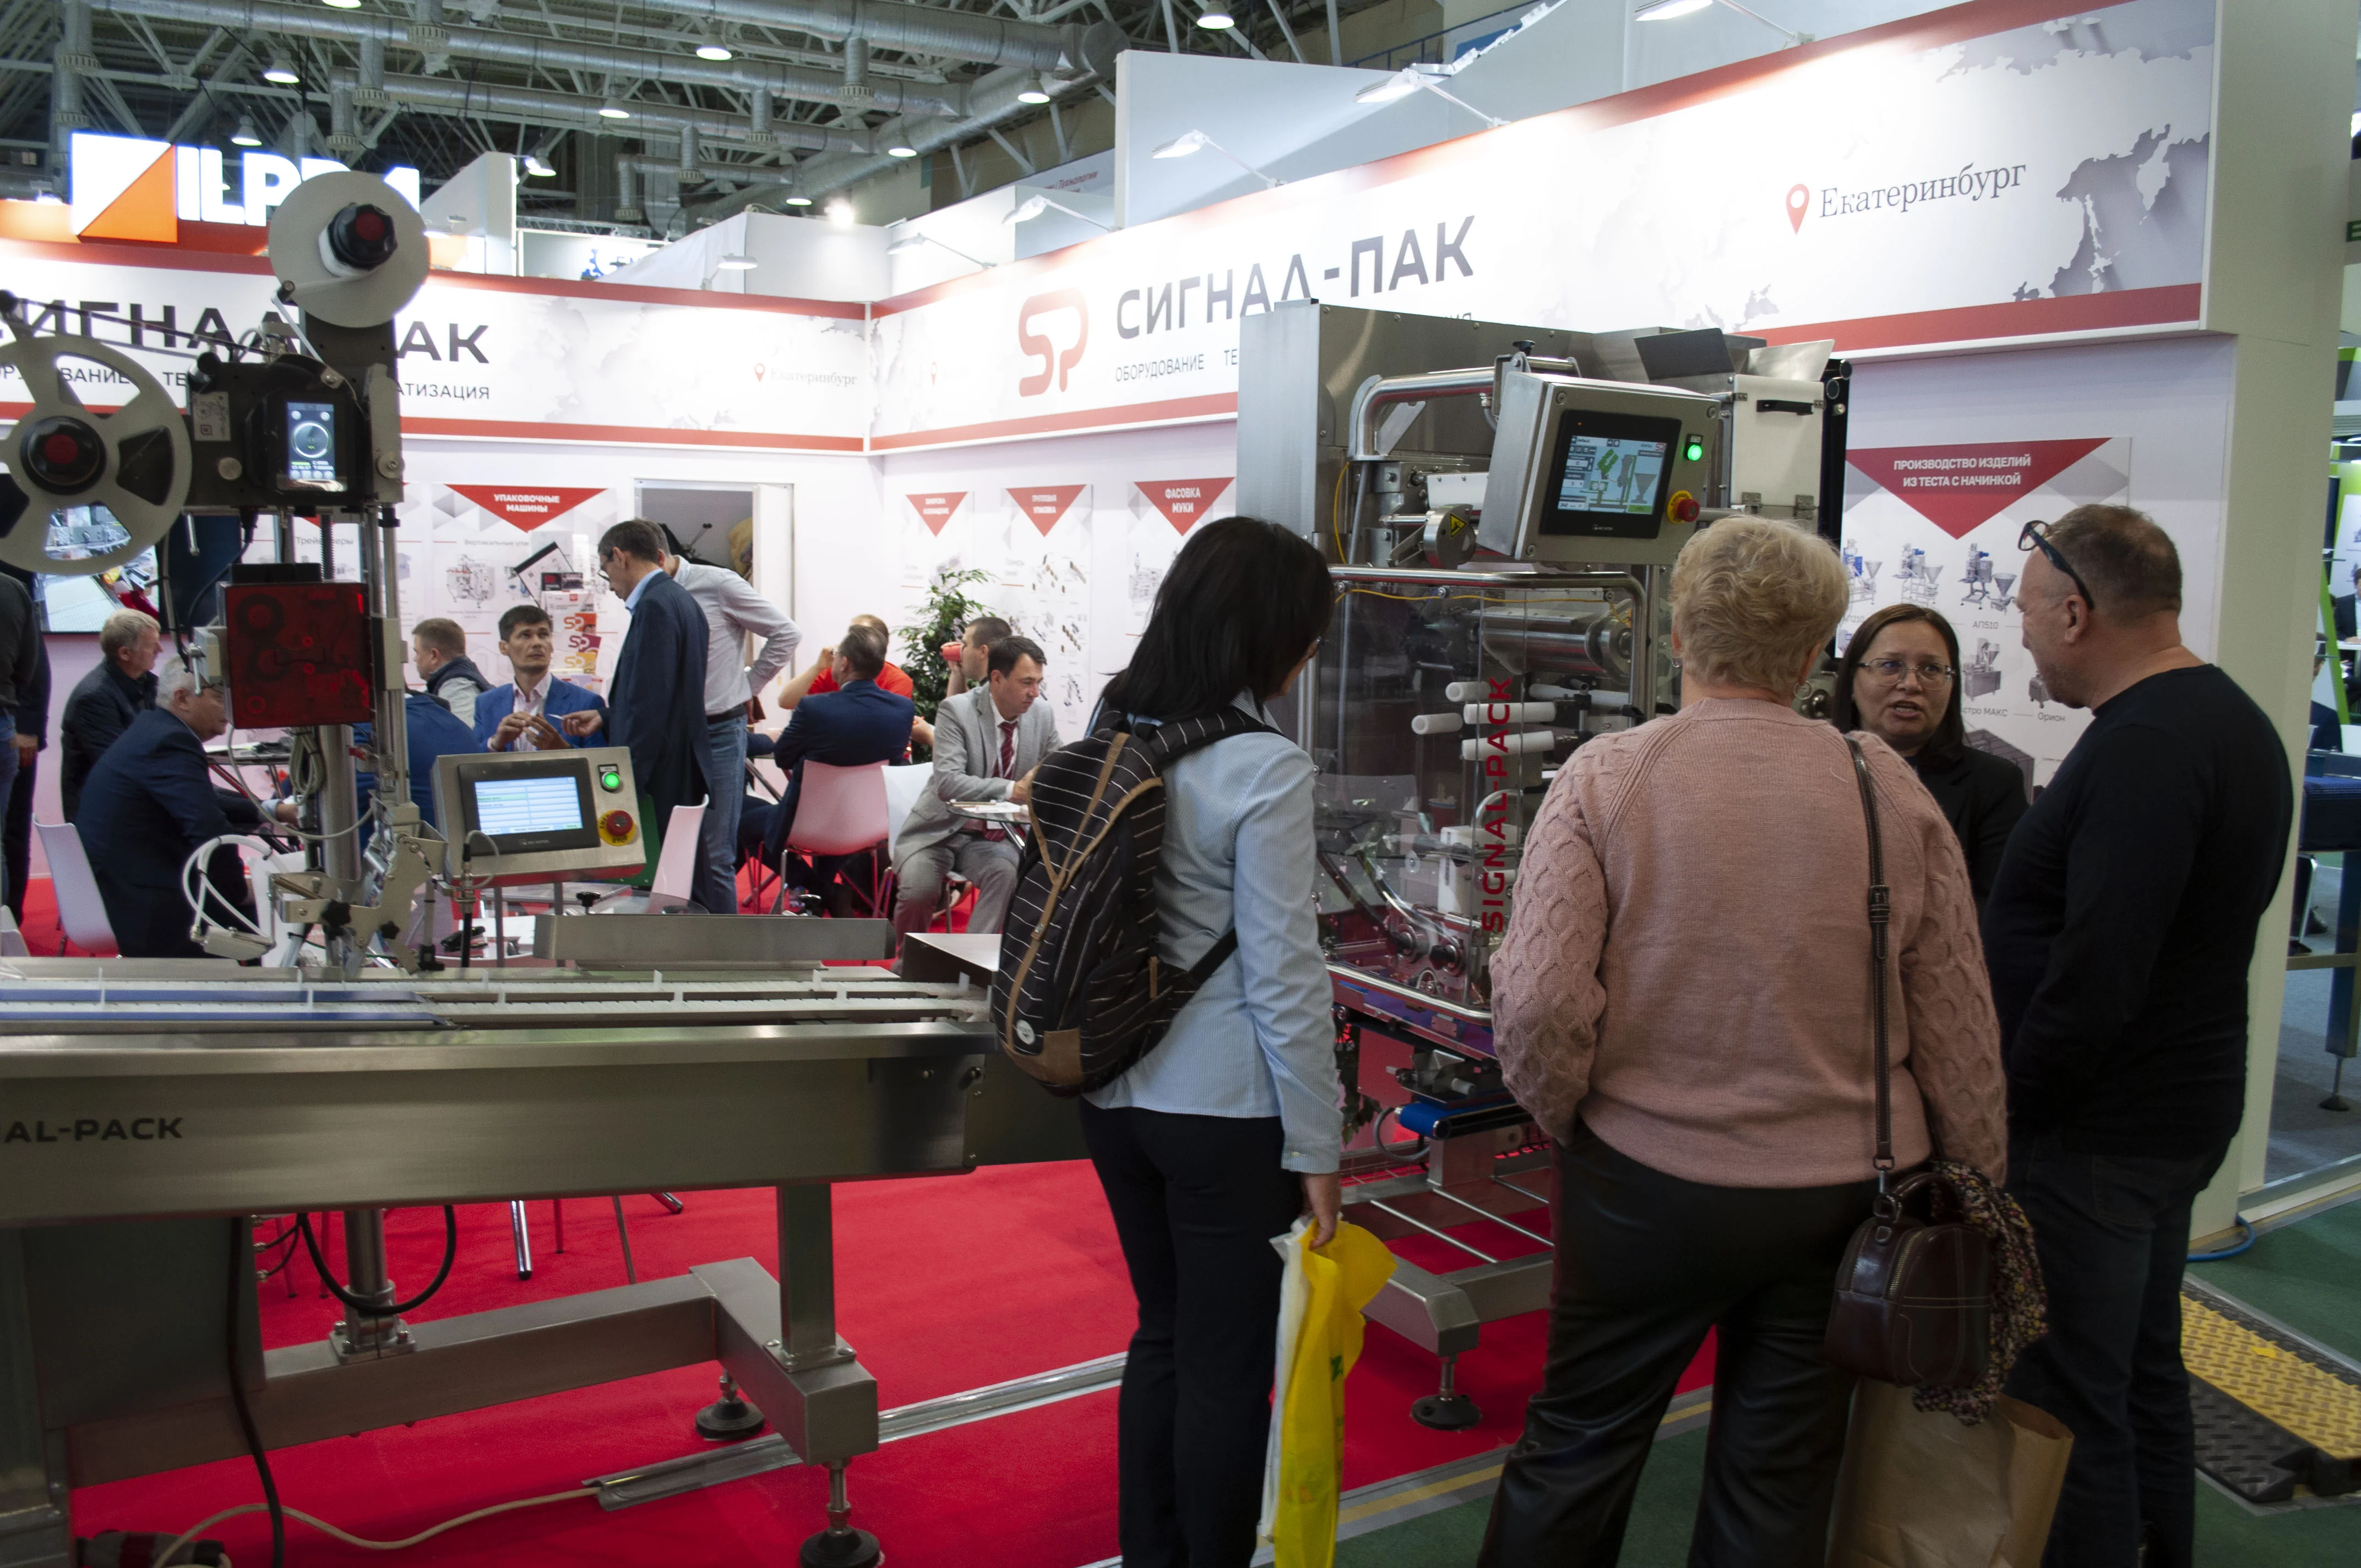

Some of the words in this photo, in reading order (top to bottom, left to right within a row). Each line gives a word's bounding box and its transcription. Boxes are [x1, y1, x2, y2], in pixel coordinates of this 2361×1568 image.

[1819, 161, 2027, 219] Екатеринбург
[1117, 215, 1475, 340] СИГНАЛ-ПАК
[1116, 353, 1205, 382] ОБОРУДОВАНИЕ
[1894, 458, 1977, 470] ПРОИЗВОДСТВО
[1978, 454, 2031, 468] ИЗДЕЛИЙ
[1903, 477, 1918, 487] ИЗ
[1918, 476, 1950, 487] ТЕСТА
[1951, 476, 1959, 486] С
[1960, 472, 2021, 486] НАЧИНКОЙ
[494, 493, 561, 503] УПАКОВОЧНЫЕ
[1165, 487, 1201, 498] ФАСОВКА
[506, 504, 548, 513] МАШИНЫ
[1172, 503, 1194, 513] МУКИ
[1973, 620, 1999, 629] АП510
[1984, 708, 2009, 717] МАКС
[2038, 712, 2066, 722] Орион
[1481, 677, 1513, 933] SIGNAL-PACK
[4, 1117, 183, 1144] AL-PACK
